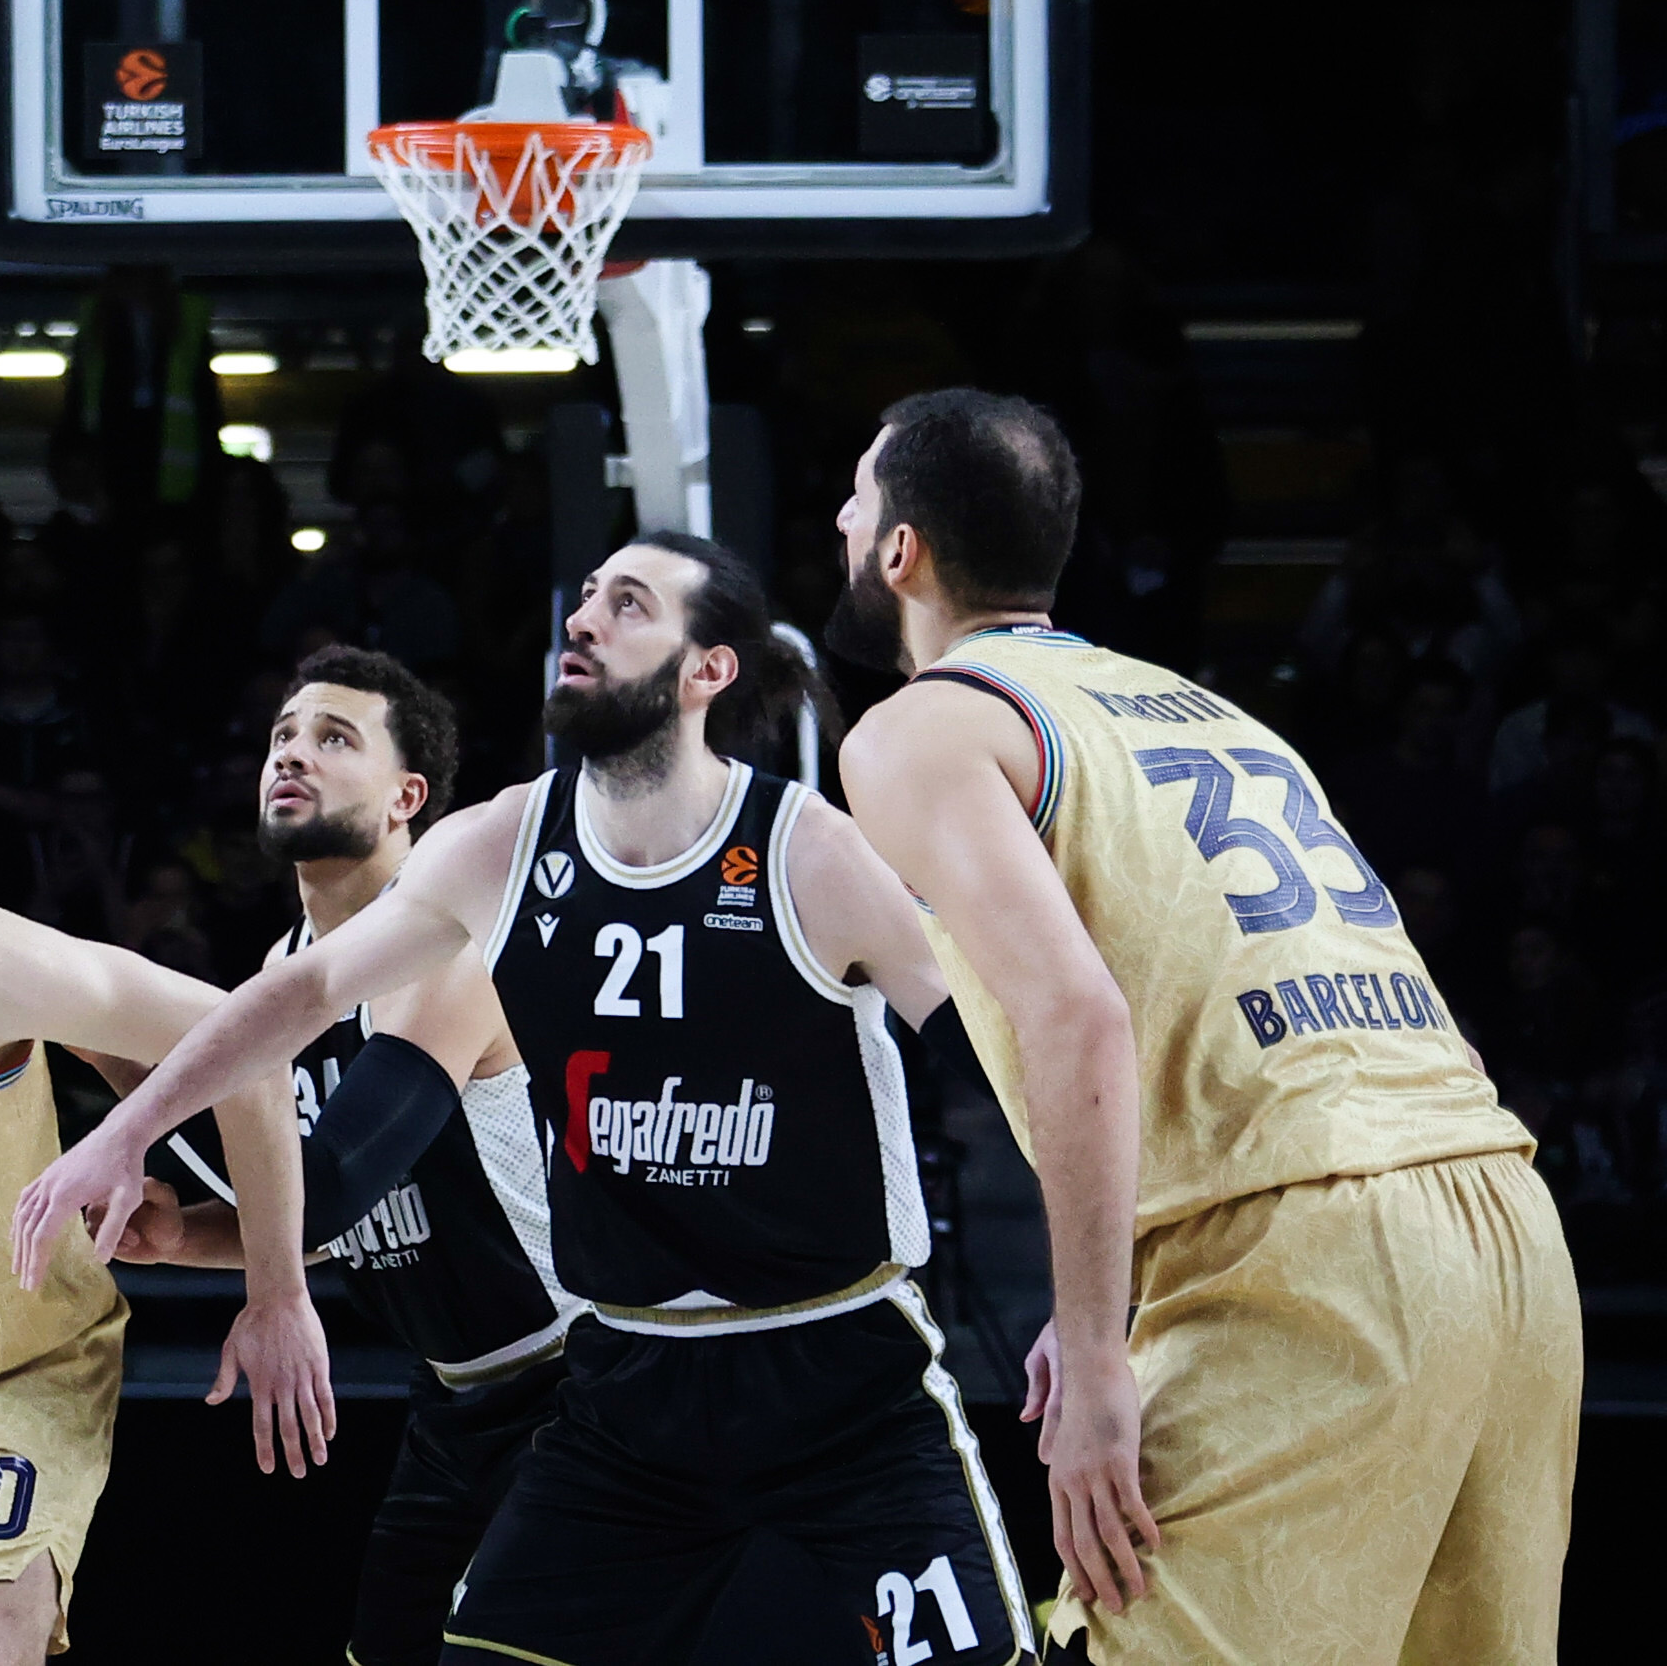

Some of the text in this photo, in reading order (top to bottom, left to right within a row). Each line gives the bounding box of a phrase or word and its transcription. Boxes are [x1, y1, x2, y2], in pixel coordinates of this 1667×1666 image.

[45, 197, 145, 220] SPALDING
[1133, 746, 1399, 937] 33
[705, 915, 762, 931] oneteam
[593, 922, 685, 1019] 21
[645, 1166, 730, 1186] ZANETTI
[875, 1556, 979, 1666] 21
